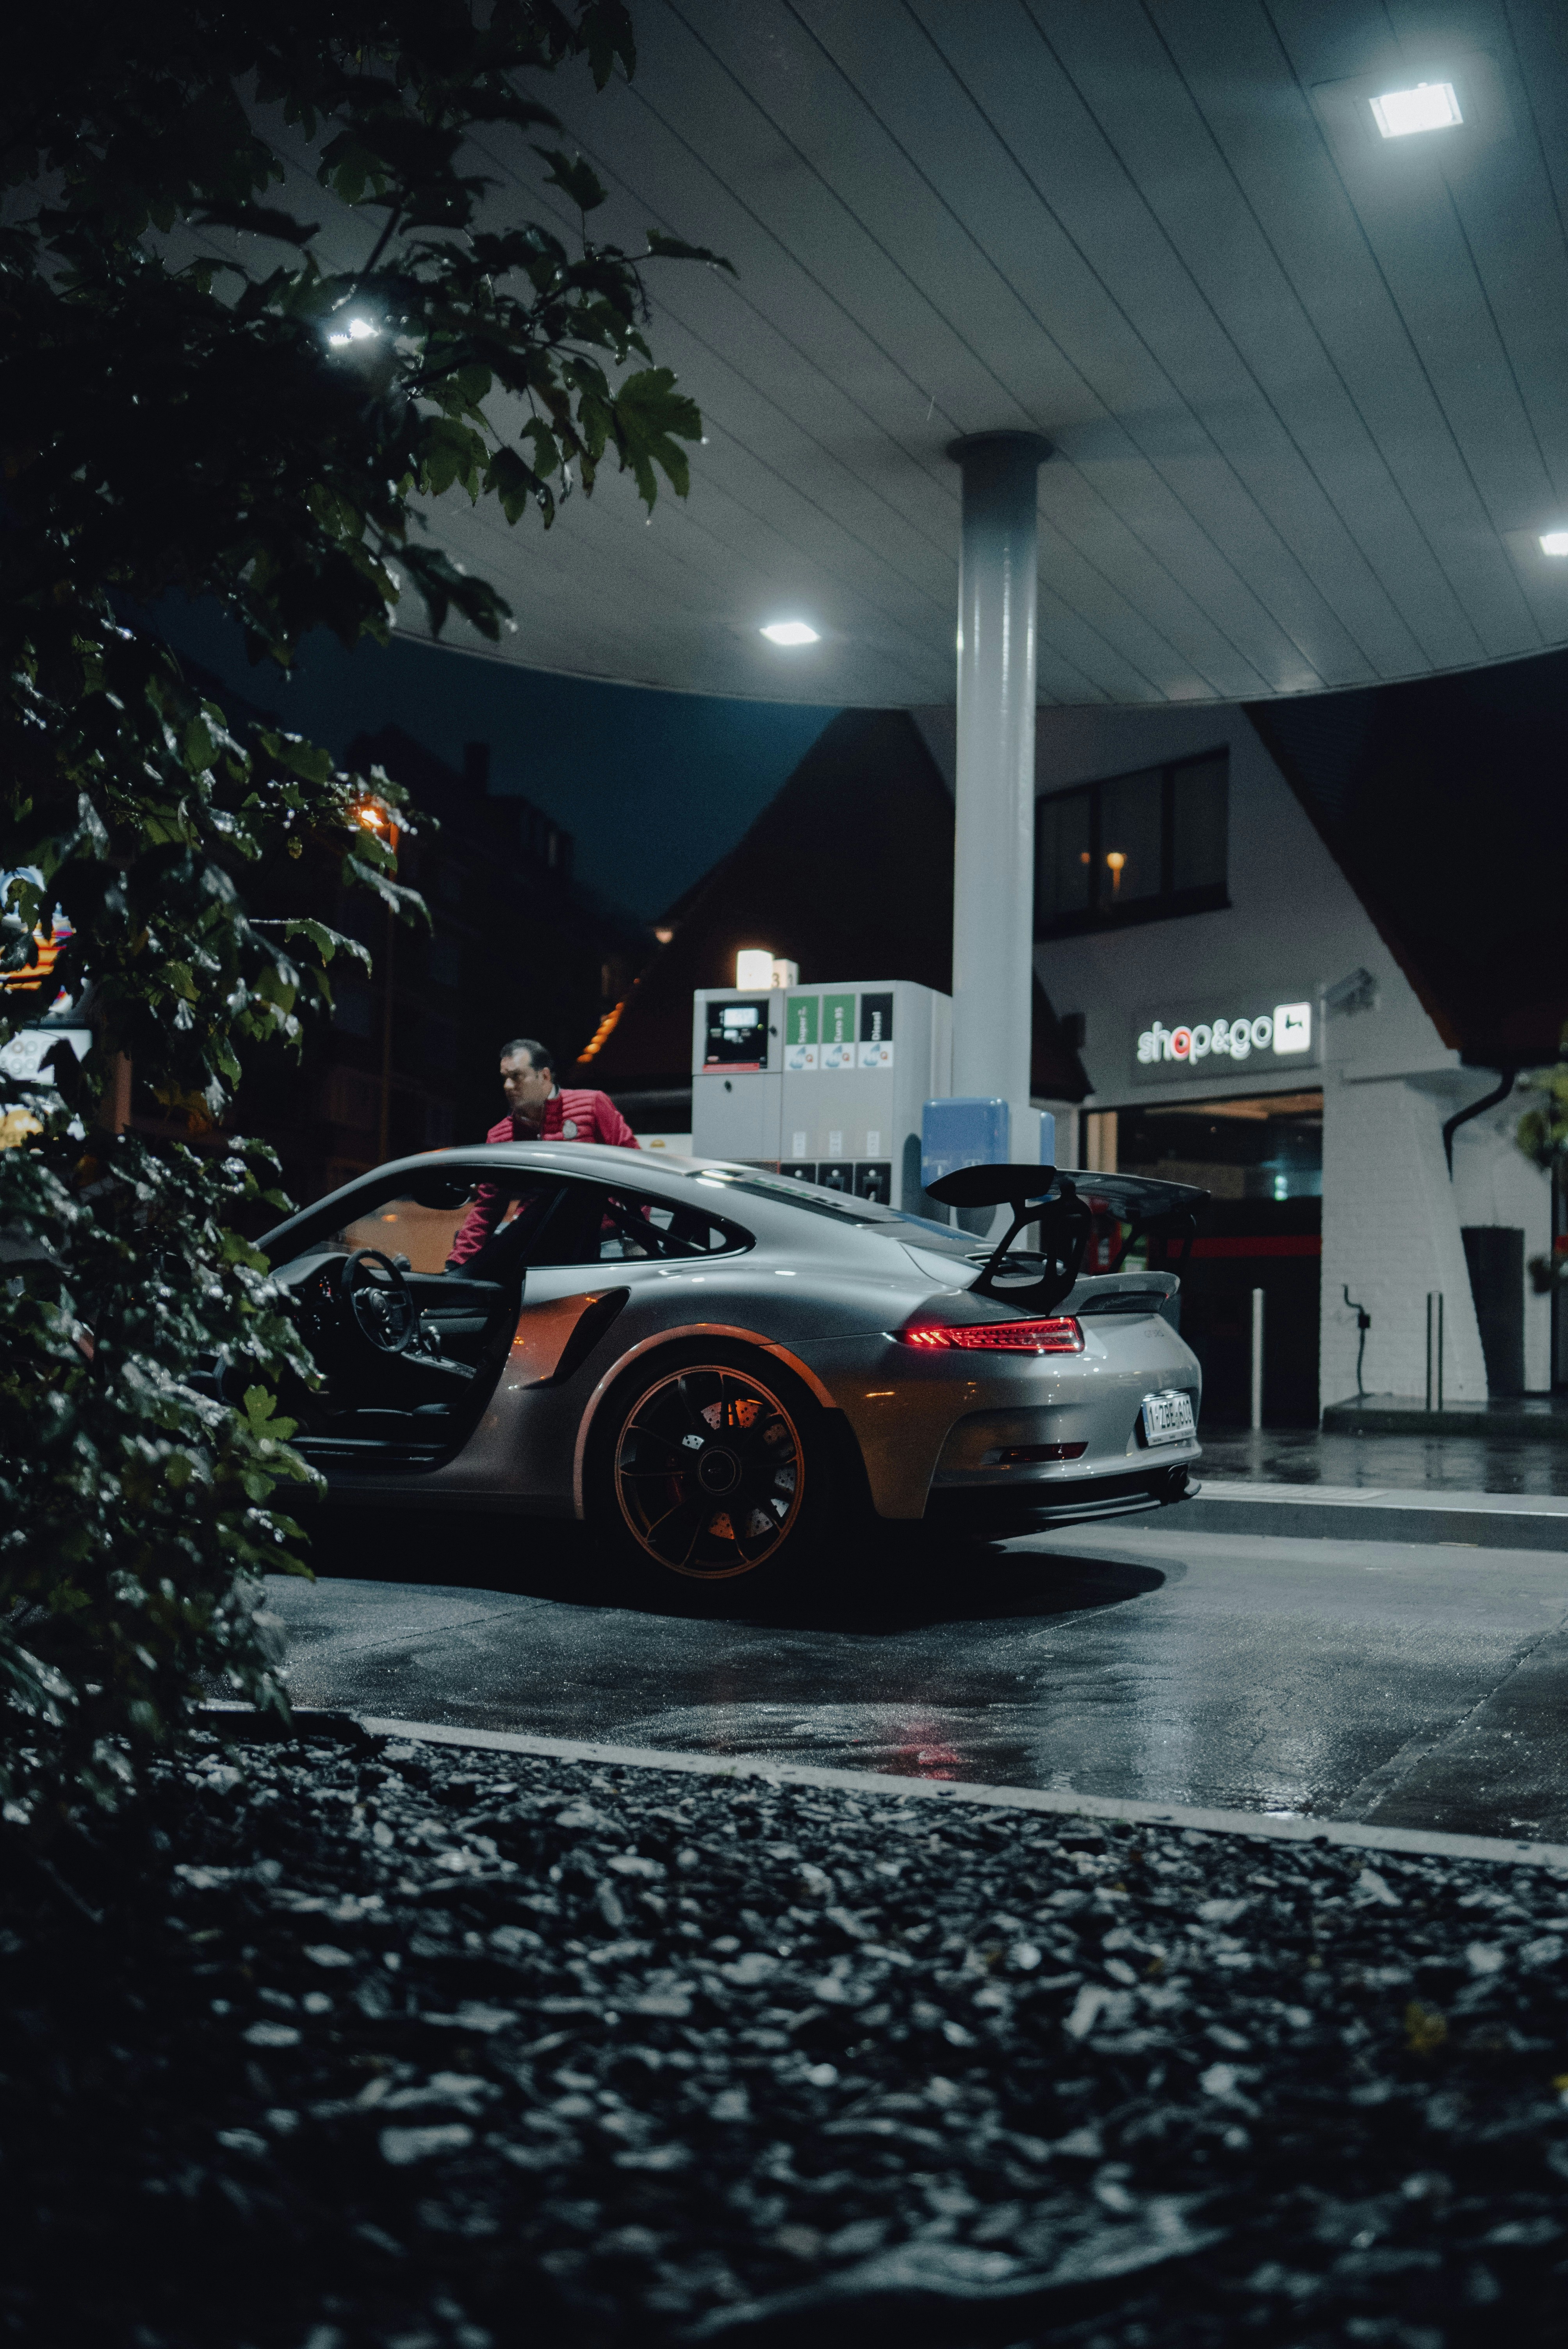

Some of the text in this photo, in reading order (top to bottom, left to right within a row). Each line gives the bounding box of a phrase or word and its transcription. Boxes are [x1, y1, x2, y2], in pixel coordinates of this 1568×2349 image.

[798, 1016, 807, 1043] Super
[834, 1020, 843, 1042] Euro
[871, 1011, 882, 1041] Diesel
[1137, 1016, 1273, 1065] shop&go
